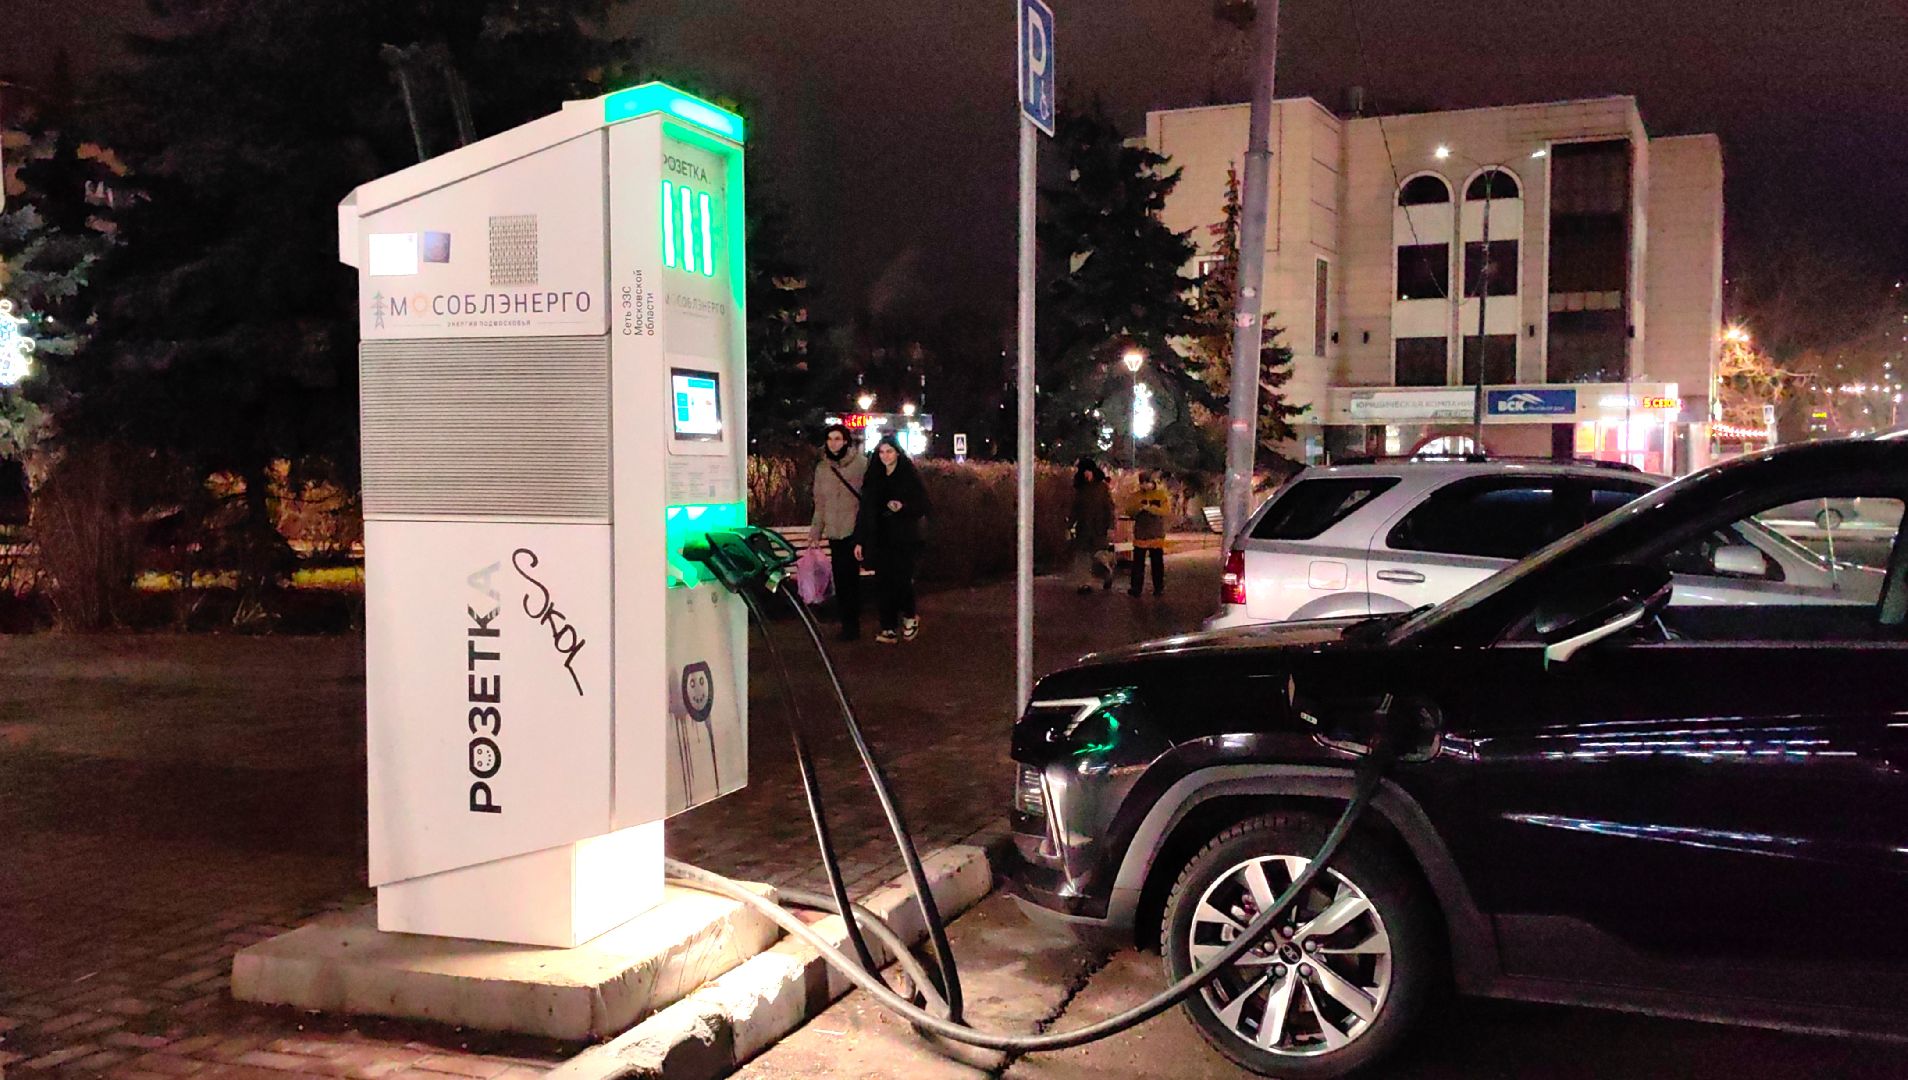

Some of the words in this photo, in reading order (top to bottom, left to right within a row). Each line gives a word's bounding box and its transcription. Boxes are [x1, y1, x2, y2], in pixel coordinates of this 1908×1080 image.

[1028, 6, 1047, 104] P
[390, 291, 591, 317] МОСОБЛЭНЕРГО
[622, 311, 632, 336] Сеть
[633, 269, 643, 336] Московской
[645, 292, 655, 336] области
[467, 560, 502, 814] РОЗЕТКА
